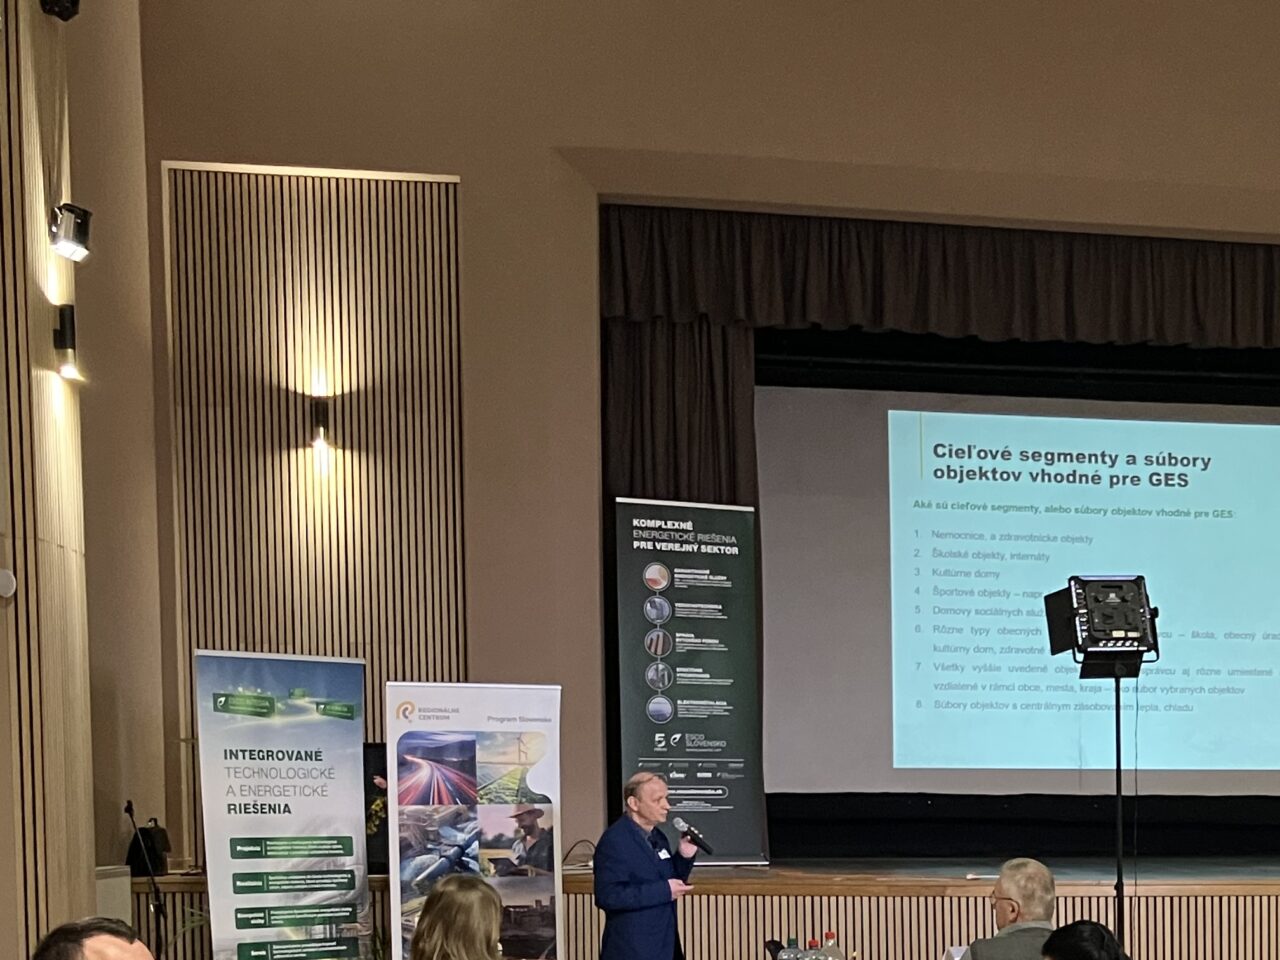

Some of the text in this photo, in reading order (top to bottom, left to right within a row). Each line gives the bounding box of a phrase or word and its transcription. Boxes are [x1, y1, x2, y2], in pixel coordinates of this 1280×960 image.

[933, 443, 1211, 471] Cieľové segmenty a súbory
[933, 465, 1189, 488] objektov vhodné pre GES
[1044, 505, 1072, 514] alebo
[1074, 504, 1109, 517] súbory
[1111, 507, 1153, 518] objektov
[1155, 507, 1191, 518] vhodné
[632, 518, 694, 531] KOMPLEXNÉ
[633, 541, 739, 555] PRE VEREJNÝ SEKTOR
[933, 606, 971, 617] Domovy
[487, 715, 518, 724] Program
[224, 748, 323, 762] INTEGROVANÉ
[225, 766, 335, 780] TECHNOLOGICKÉ
[226, 783, 328, 797] A ENERGETICKÉ
[227, 800, 292, 815] RIEŠENIA
